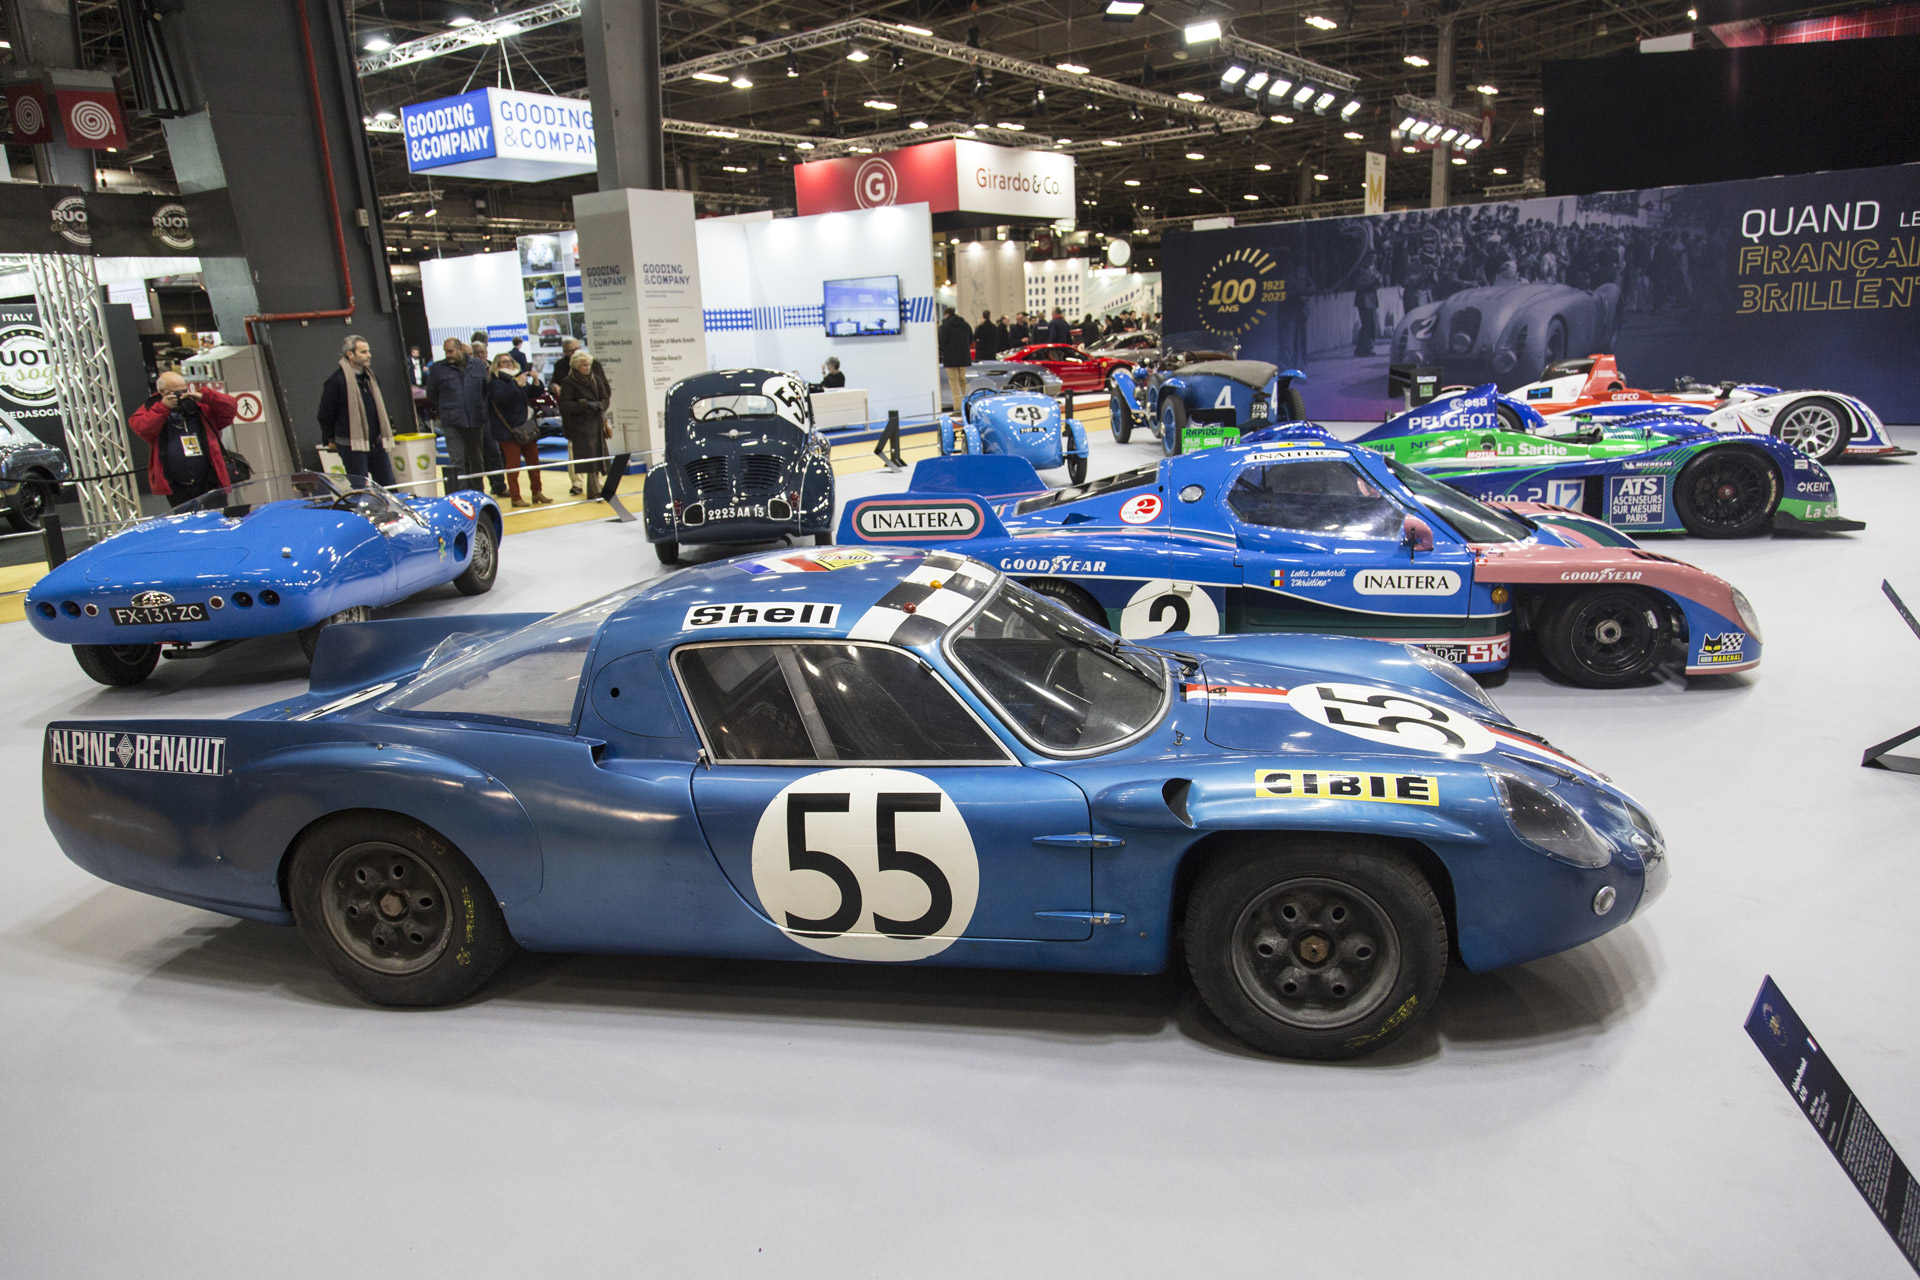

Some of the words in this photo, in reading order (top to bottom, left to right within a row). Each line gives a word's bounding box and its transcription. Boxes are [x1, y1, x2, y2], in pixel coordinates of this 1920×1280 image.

[406, 103, 475, 138] GOODING
[500, 100, 593, 130] GOODING
[411, 125, 489, 162] &COMPANY
[504, 126, 596, 154] &COMPAN
[865, 172, 885, 201] G
[976, 168, 1030, 192] Girardo
[1032, 174, 1041, 193] &
[1043, 176, 1062, 195] Co.
[1369, 174, 1383, 207] M
[51, 210, 88, 222] RUO
[152, 216, 189, 228] RUOT
[1741, 200, 1880, 243] QUAND
[1738, 236, 1920, 277] FRANÇAI
[586, 265, 620, 277] GOODING
[643, 263, 683, 274] GOODING
[588, 276, 627, 288] &COMPANY
[644, 276, 690, 286] &COMPANY
[1208, 278, 1257, 305] 100
[1263, 280, 1285, 290] 1923
[1261, 291, 1286, 302] 2023
[1736, 277, 1920, 314] BRILLEN
[1217, 304, 1240, 313] ANS
[1, 313, 33, 321] ITALY
[0, 350, 50, 366] UOT
[17, 366, 54, 385] sog
[1214, 385, 1236, 409] 4
[1611, 393, 1640, 401] GEFCO
[1014, 406, 1042, 420] 48
[1408, 413, 1496, 430] PEUGEOT
[1253, 451, 1338, 460] INALTERA
[1466, 451, 1497, 459] MOTUL
[1497, 443, 1514, 455] La
[1518, 443, 1567, 456] Sarthe
[1635, 460, 1673, 468] MICHELIN
[1619, 478, 1658, 496] ATS
[1806, 481, 1830, 492] KENT
[1555, 483, 1582, 509] 17
[1612, 495, 1663, 504] ASCENSEURS
[707, 507, 736, 520] 2223
[737, 506, 750, 518] AA
[753, 505, 765, 518] 13
[1134, 498, 1157, 515] 2
[1613, 505, 1628, 514] SUR
[1631, 504, 1662, 513] MESURE
[1805, 505, 1822, 519] La
[1824, 505, 1838, 518] Sa
[872, 511, 964, 529] INALTERA
[1625, 514, 1648, 523] PARIS
[1311, 569, 1346, 578] Lombardi
[1364, 575, 1449, 589] INALTERA
[115, 605, 203, 624] FX-131-ZC
[690, 604, 834, 626] Shell
[1149, 594, 1190, 633] 2
[1467, 641, 1508, 663] SK
[1712, 654, 1741, 663] MARCHAL
[1316, 686, 1466, 749] 55
[53, 730, 116, 767] ALPINE
[135, 734, 224, 774] RENAULT
[785, 792, 952, 940] 55
